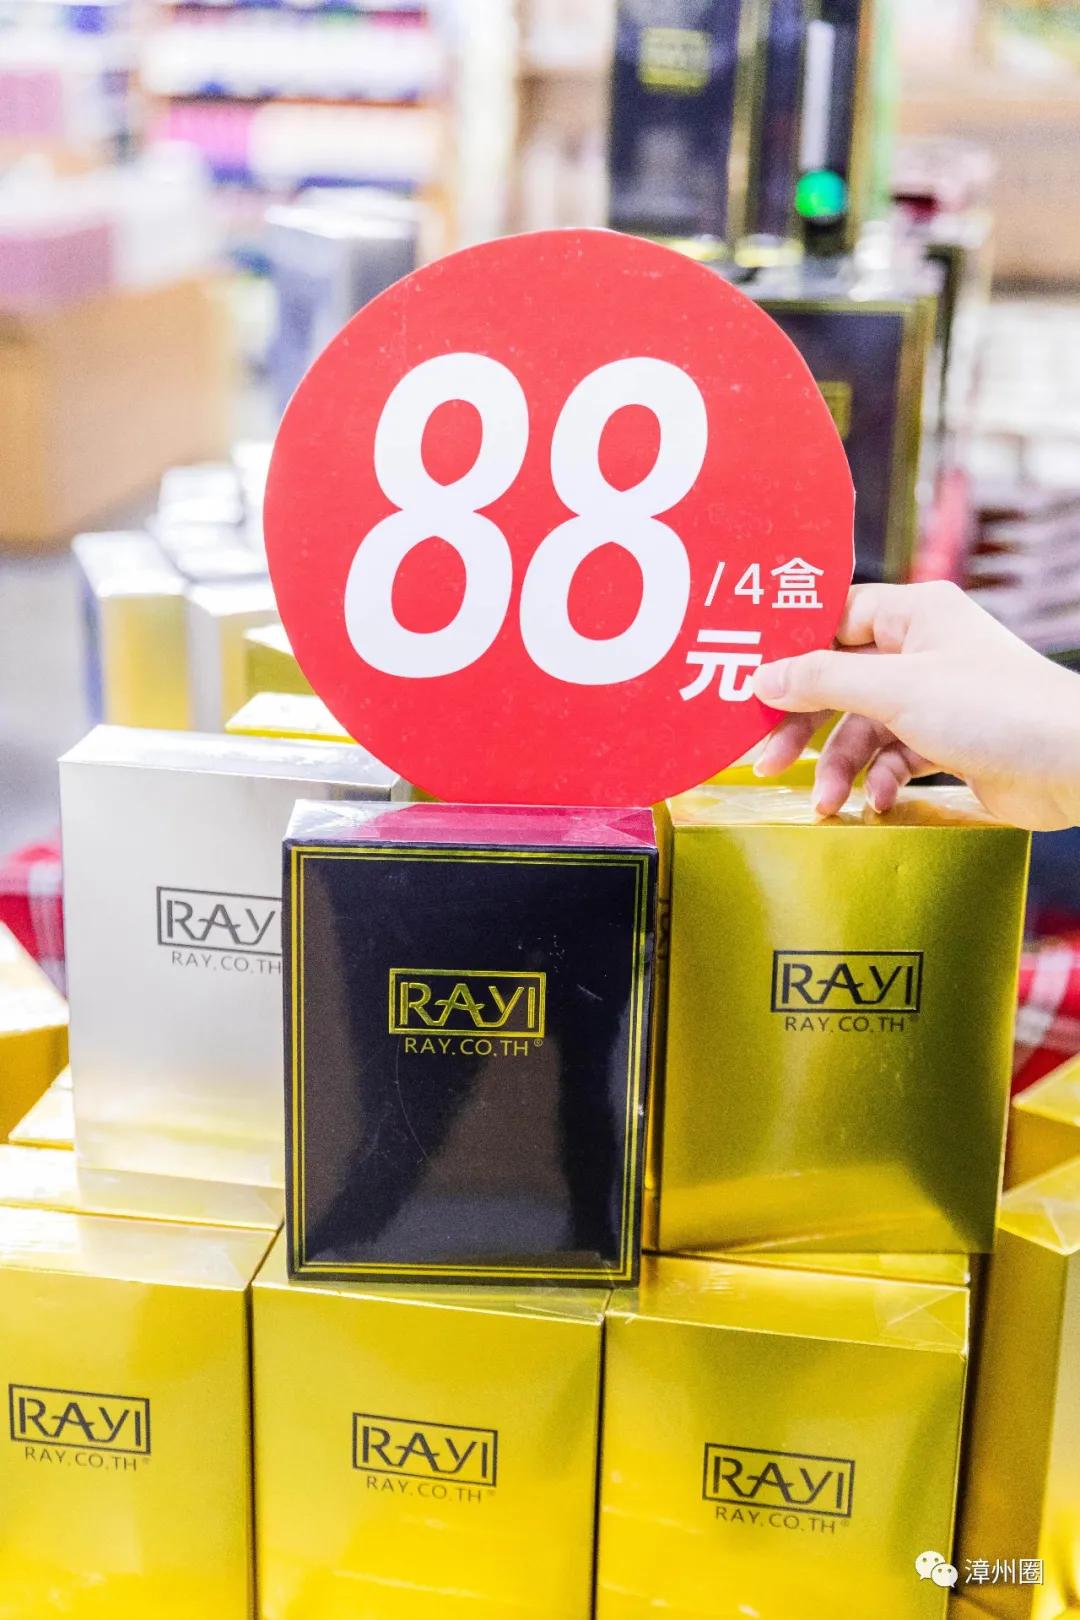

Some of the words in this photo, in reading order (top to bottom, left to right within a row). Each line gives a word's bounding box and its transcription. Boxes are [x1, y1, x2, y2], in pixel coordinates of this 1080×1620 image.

[344, 352, 708, 685] 88
[680, 630, 763, 702] 元
[166, 899, 276, 945] RAY
[400, 981, 536, 1029] RAYI
[781, 962, 914, 1006] RAYI
[18, 1396, 142, 1447] RAYI
[362, 1426, 488, 1479] RAYI
[712, 1455, 845, 1509] RAYI
